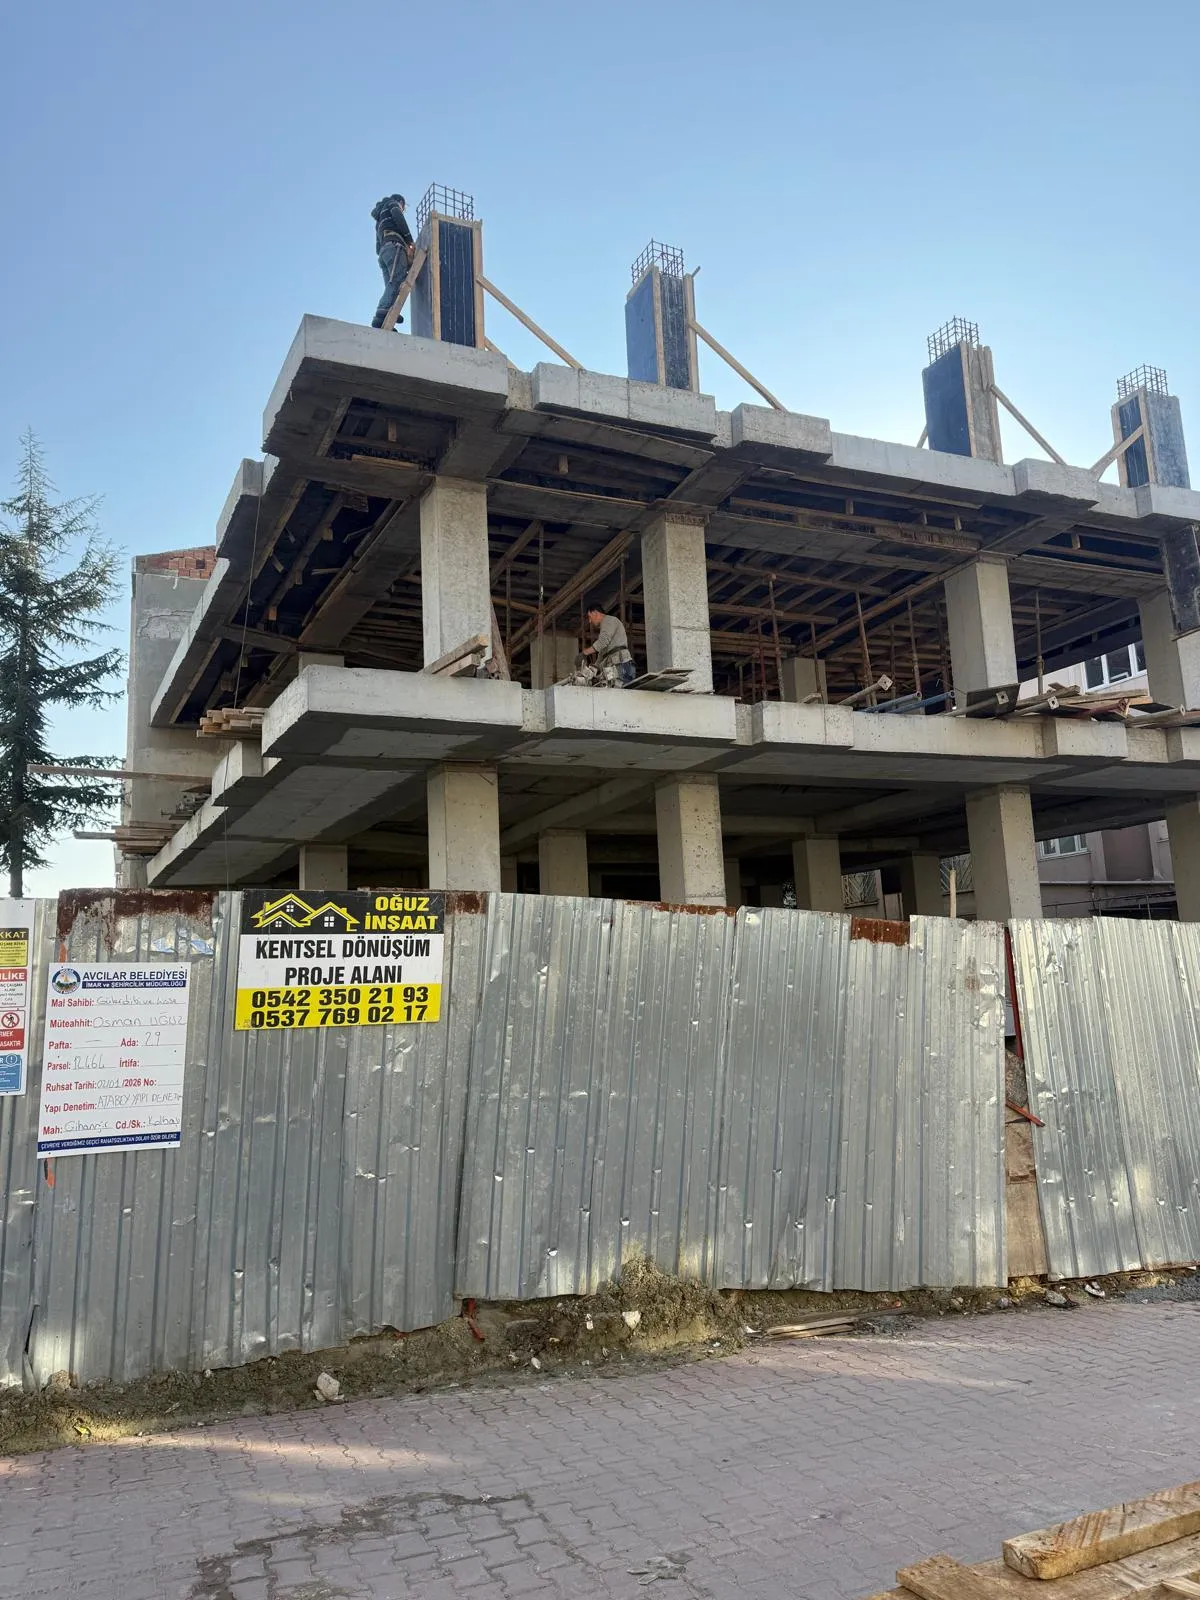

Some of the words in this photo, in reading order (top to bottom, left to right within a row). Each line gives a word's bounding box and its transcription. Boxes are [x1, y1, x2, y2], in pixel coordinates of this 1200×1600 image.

[375, 894, 430, 912] OĞUZ
[364, 912, 439, 931] İNŞAAT
[256, 940, 337, 959] KENTSEL
[342, 936, 431, 959] DÖNÜŞÜM
[82, 971, 127, 980] AVCILAR
[129, 969, 188, 980] BELEDİYESİ
[285, 967, 345, 985] PROJE
[349, 966, 402, 984] ALANI
[110, 980, 145, 988] ŞEHİRCİLİK
[146, 979, 184, 987] MÜDÜRLÜĞÜ
[51, 999, 65, 1007] Mal
[67, 997, 95, 1007] Sahibi:
[251, 990, 311, 1008] 0542
[318, 988, 361, 1006] 350
[368, 987, 393, 1004] 21
[402, 986, 429, 1003] 93
[50, 1016, 93, 1028] Müteahhit:
[93, 1017, 142, 1028] Osman
[250, 1010, 310, 1028] 0537
[318, 1007, 360, 1025] 769
[367, 1006, 395, 1023] 02
[402, 1005, 428, 1021] 17
[48, 1041, 72, 1050] Pafta:
[120, 1038, 139, 1047] Ada:
[47, 1061, 71, 1071] Parsel:
[119, 1058, 140, 1068] İrtifa:
[46, 1082, 73, 1092] Ruhsat
[74, 1080, 97, 1090] Tarihi:
[122, 1077, 142, 1088] /2026
[143, 1077, 157, 1087] No:
[44, 1104, 62, 1115] Yapı
[63, 1101, 97, 1112] Denetim:
[43, 1126, 63, 1136] Mah:
